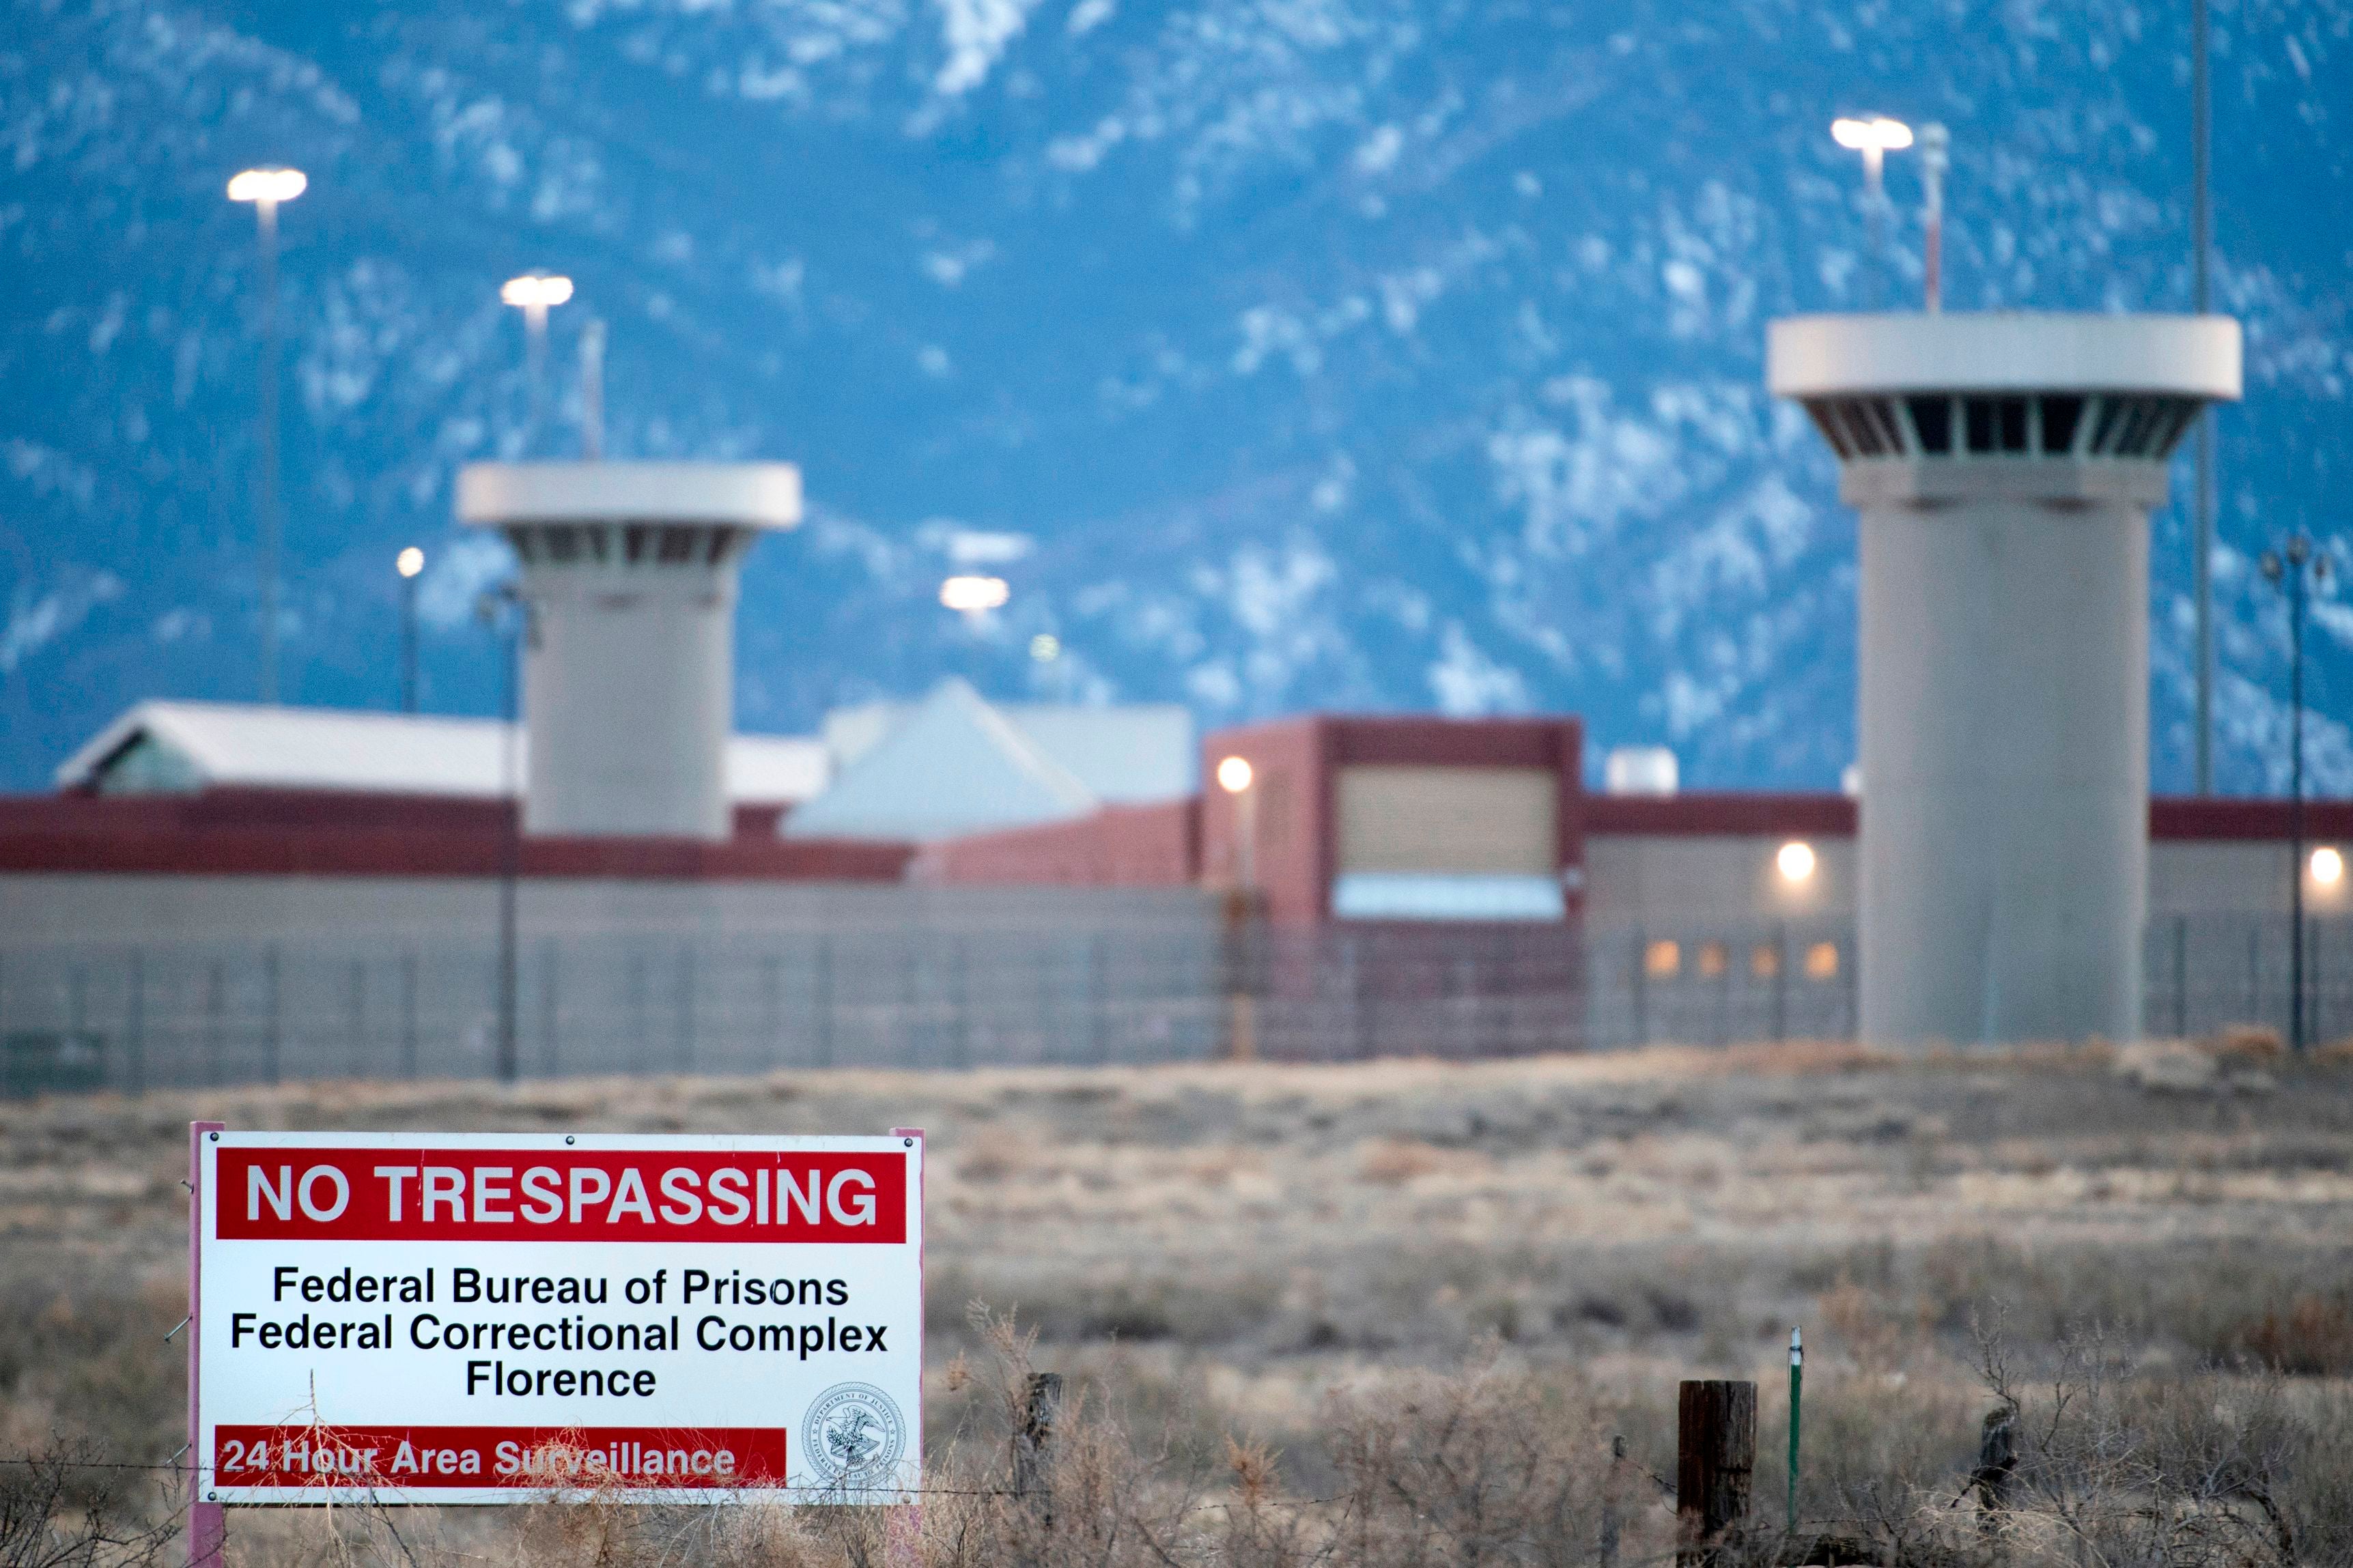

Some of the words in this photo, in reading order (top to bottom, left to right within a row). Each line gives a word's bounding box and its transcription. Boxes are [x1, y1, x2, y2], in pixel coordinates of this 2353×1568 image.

[246, 1165, 350, 1222] NO
[374, 1166, 876, 1226] TRESPASSING
[274, 1266, 434, 1303] Federal
[453, 1268, 608, 1305] Bureau
[625, 1269, 666, 1305] of
[684, 1269, 849, 1306] Prisons
[232, 1313, 393, 1350] Federal
[410, 1313, 679, 1352] Correctional
[696, 1315, 888, 1356] Complex
[468, 1360, 657, 1397] Florence
[223, 1440, 269, 1472] 24
[282, 1440, 378, 1474] Hour
[391, 1440, 481, 1474] Area
